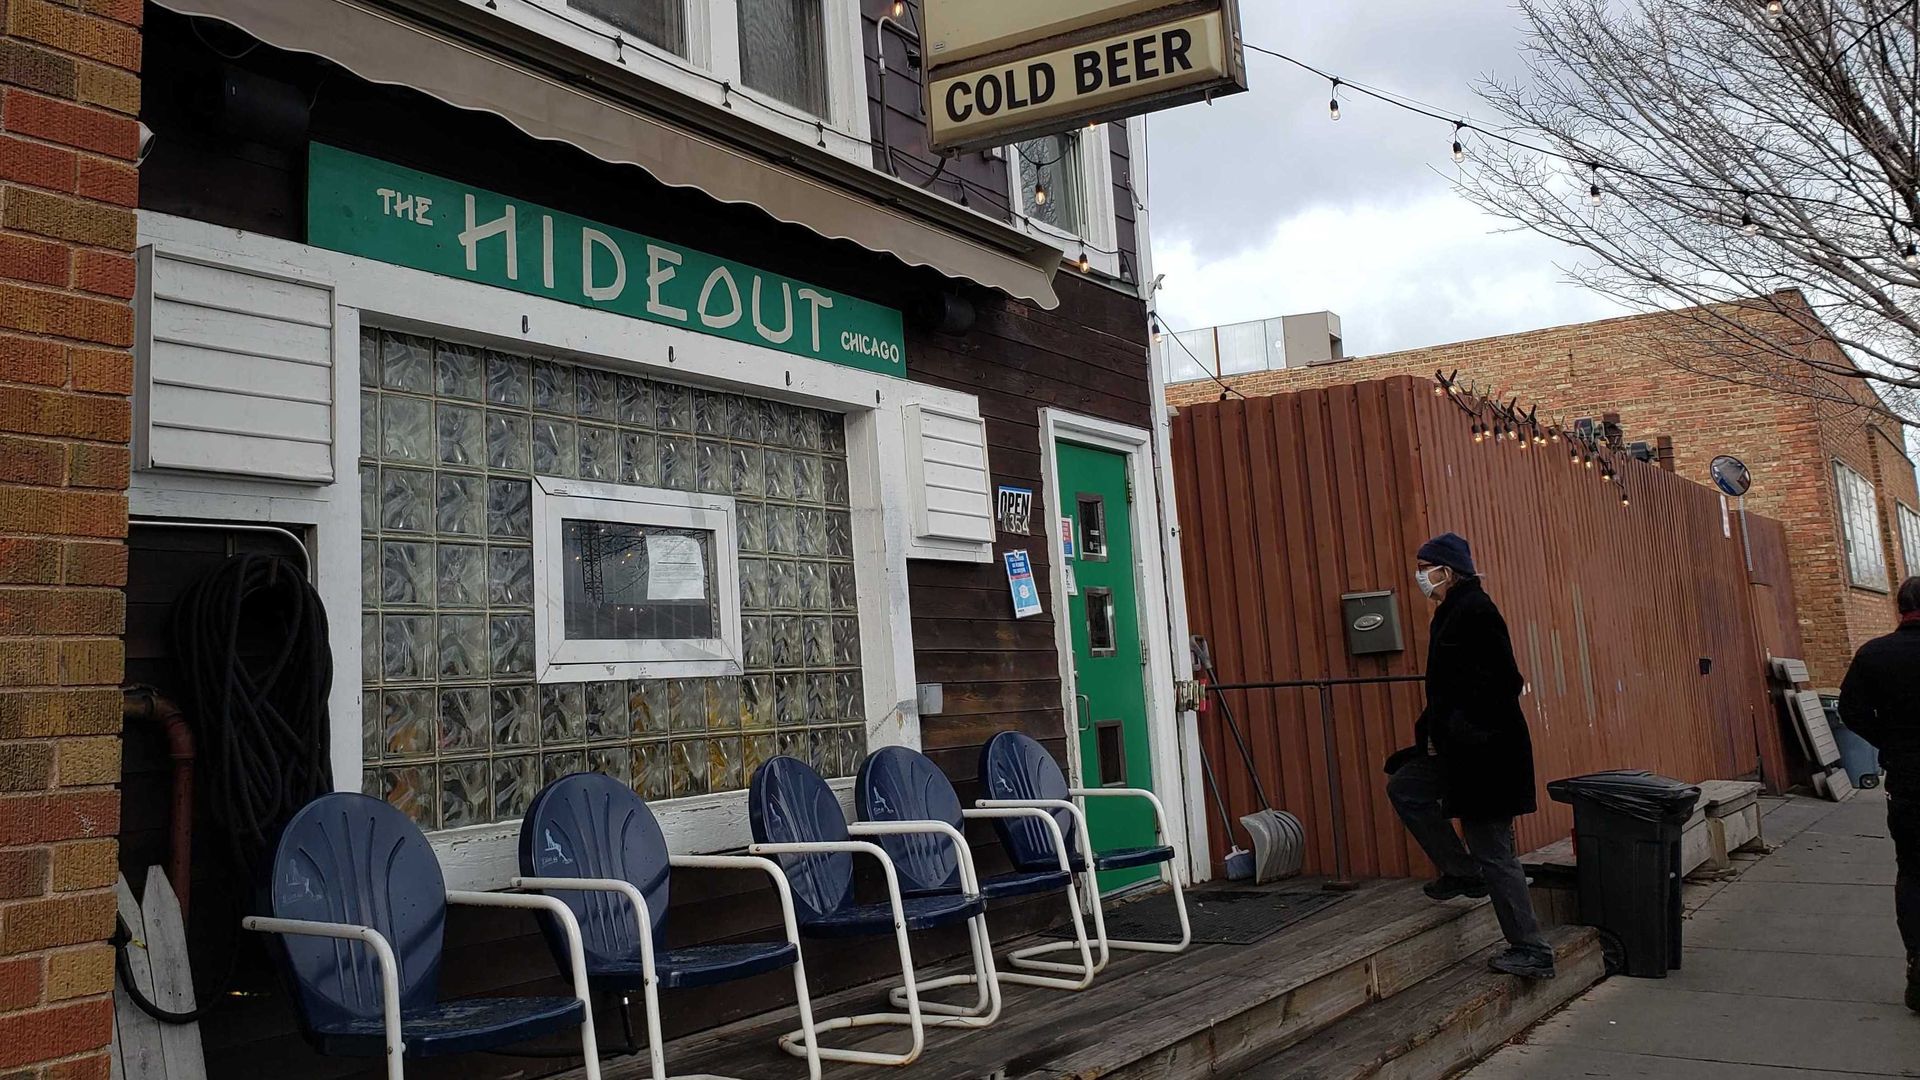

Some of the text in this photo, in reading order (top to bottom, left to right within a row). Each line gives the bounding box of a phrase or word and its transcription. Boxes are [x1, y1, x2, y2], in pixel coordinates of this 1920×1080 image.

[945, 28, 1193, 123] COLD BEER
[376, 188, 900, 364] THE HIDEOUT CHICAGO
[1000, 491, 1030, 516] OPEN
